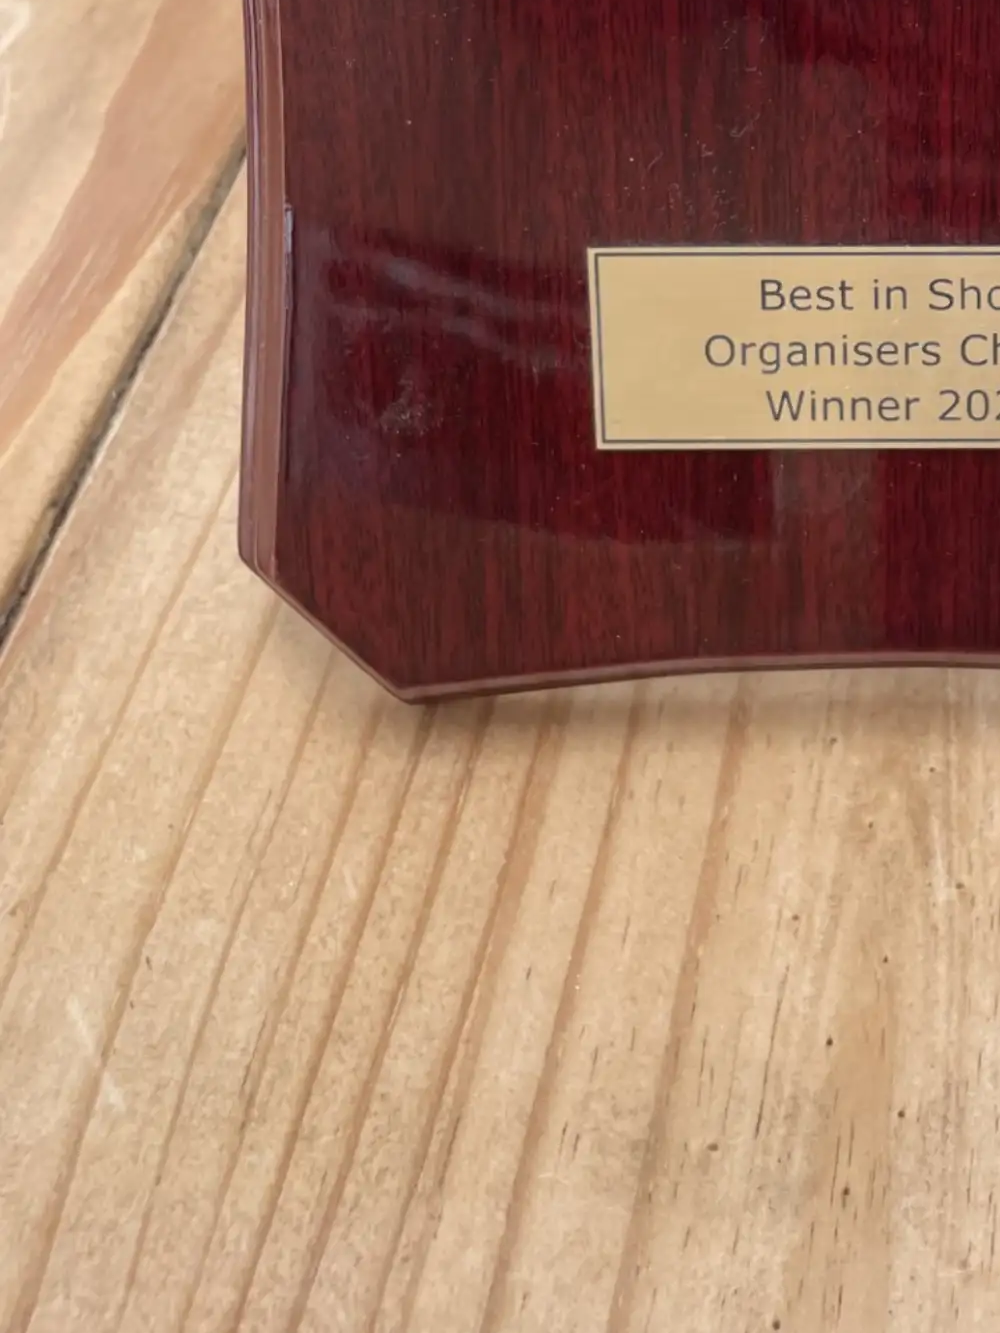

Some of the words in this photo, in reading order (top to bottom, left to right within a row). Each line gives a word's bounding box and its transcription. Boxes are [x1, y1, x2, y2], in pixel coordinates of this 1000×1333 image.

[760, 278, 854, 311] Best
[873, 278, 907, 311] in
[705, 333, 941, 374] Organisers
[766, 390, 920, 422] Winner
